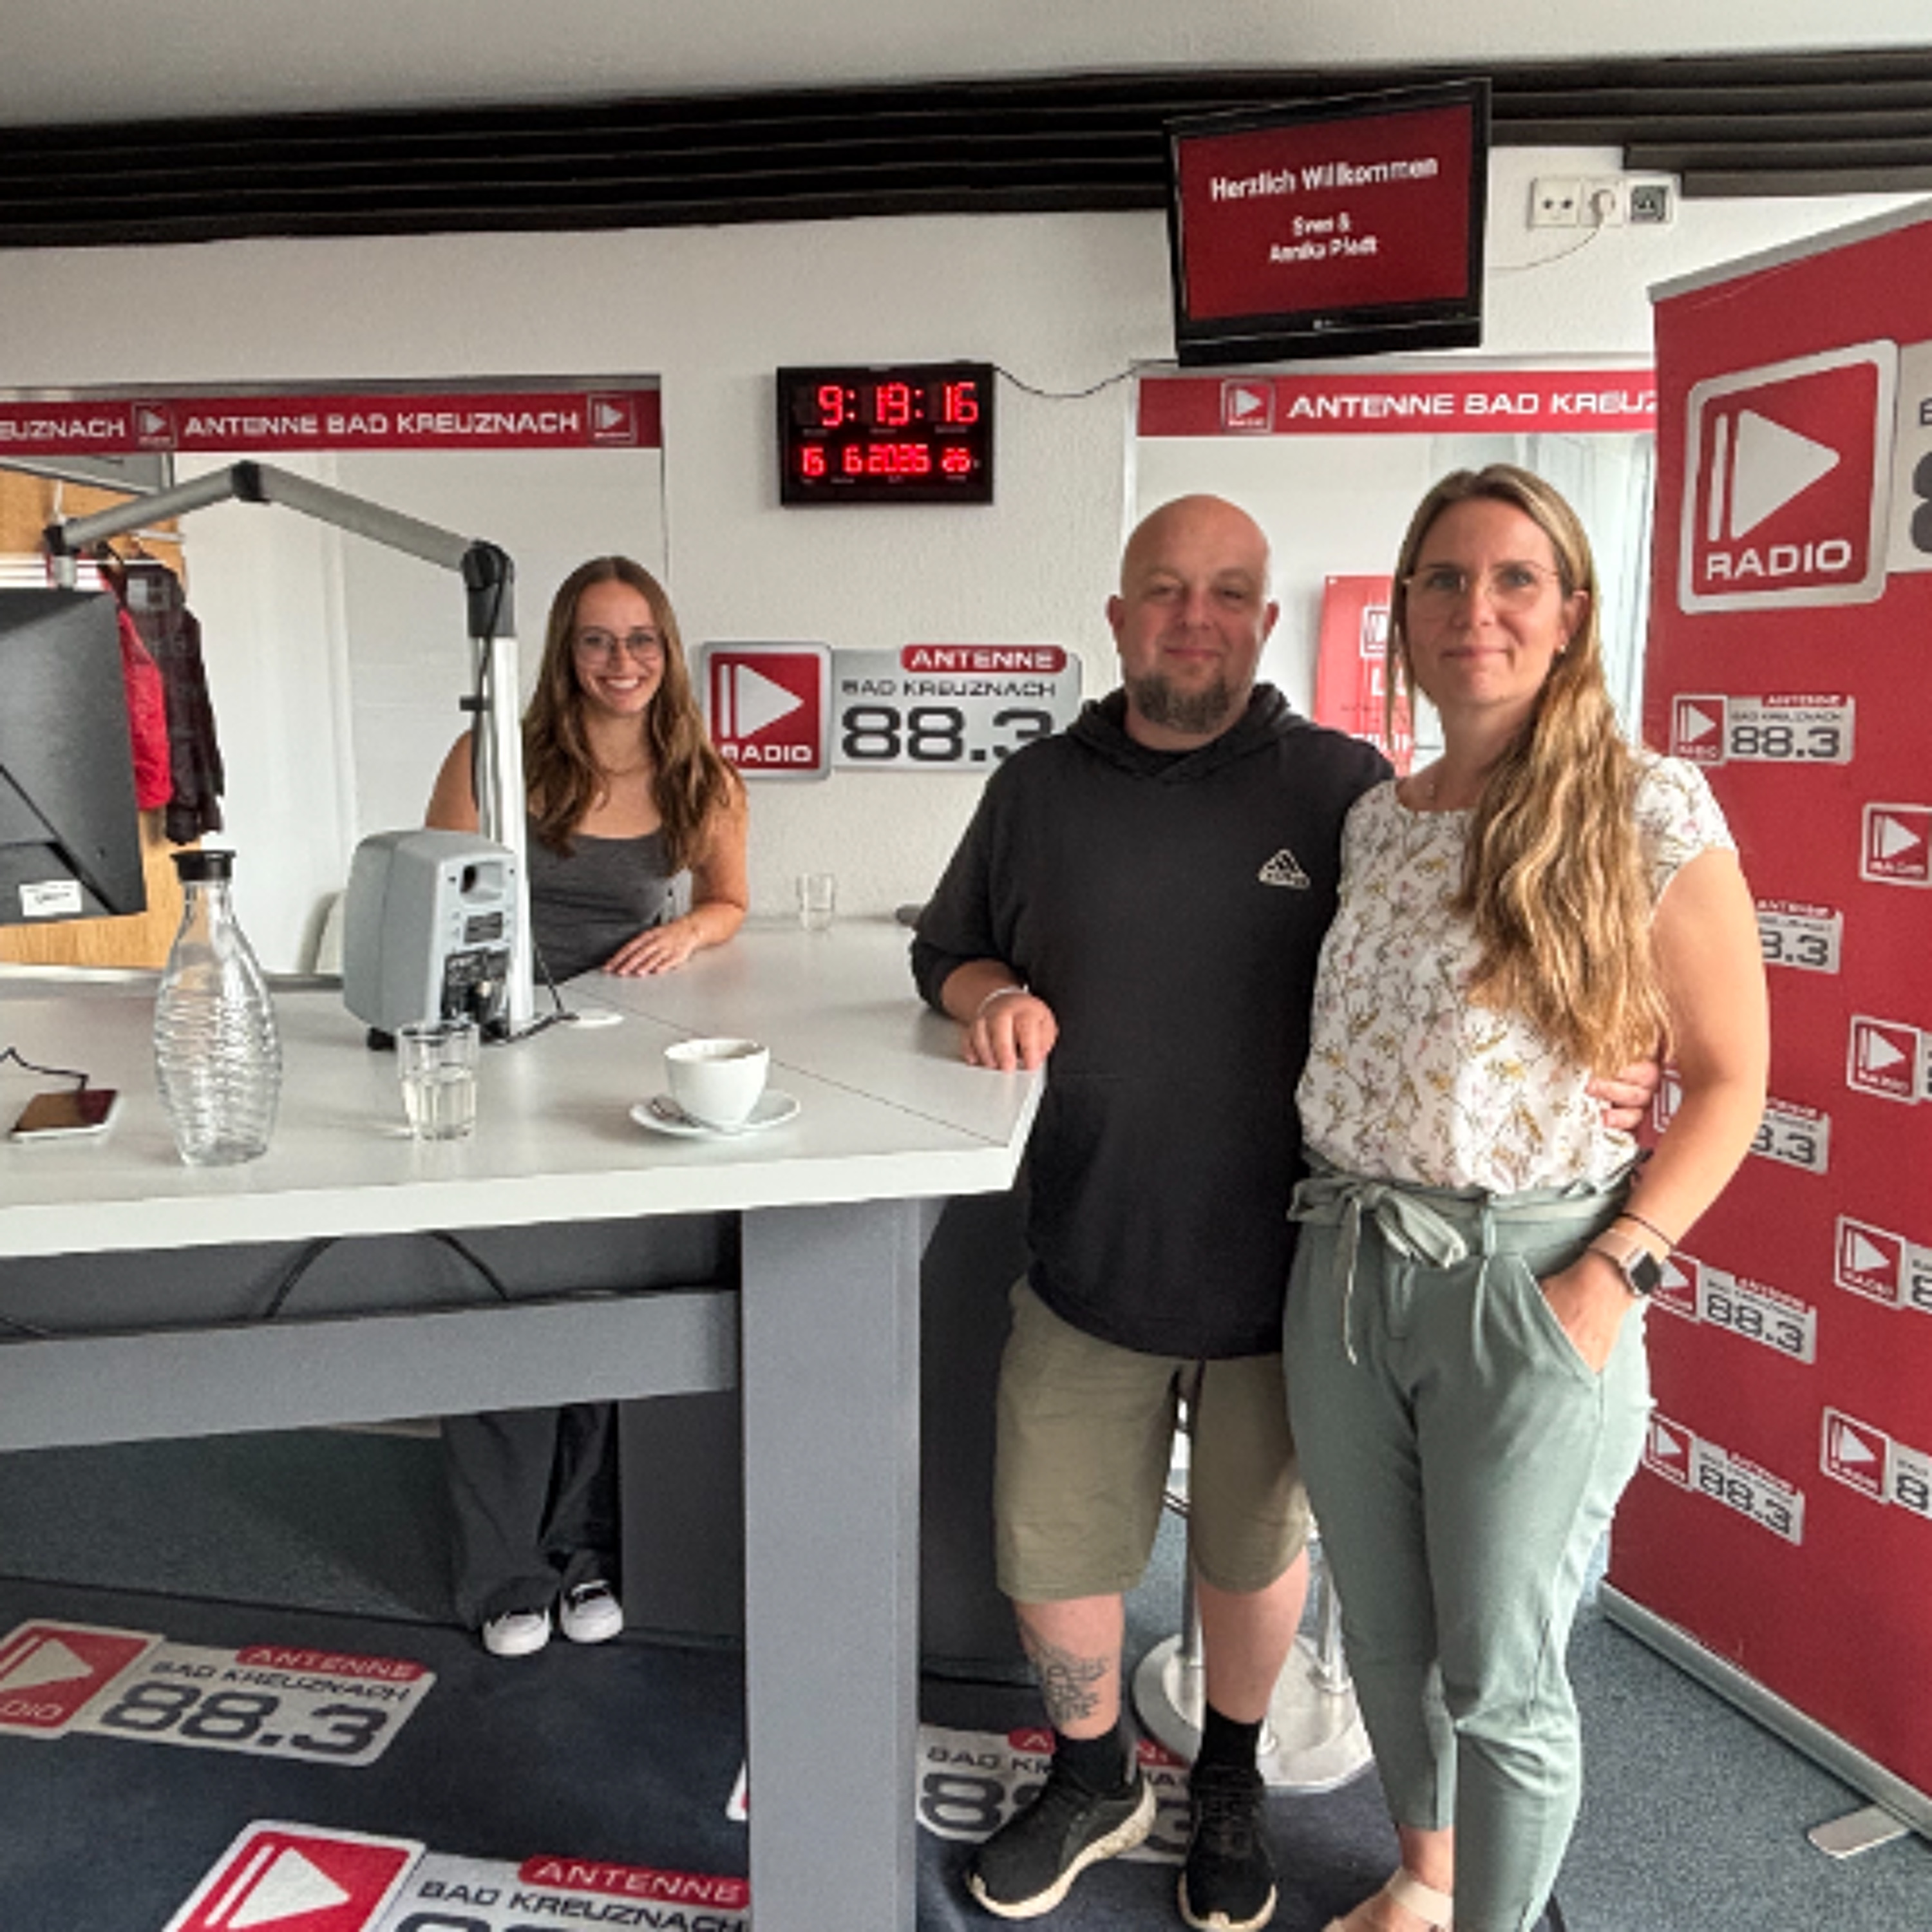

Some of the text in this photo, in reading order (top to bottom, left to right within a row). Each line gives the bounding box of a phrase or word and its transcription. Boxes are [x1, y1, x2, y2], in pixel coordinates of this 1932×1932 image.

[1211, 157, 1439, 201] Herzlich Willkommen
[1287, 393, 1454, 419] ANTENNE
[1463, 392, 1540, 415] BAD
[184, 412, 578, 437] ANTENNE BAD KREUZNACH
[1707, 540, 1852, 581] RADIO
[910, 650, 1055, 669] ANTENNE
[842, 679, 1056, 697] BAD KREUZNACH
[720, 744, 812, 762] RADIO
[1731, 725, 1841, 758] 88.3
[1707, 1293, 1803, 1354] 88.3
[1699, 1463, 1793, 1535] 88.3
[247, 1647, 420, 1679] ANTENNE
[150, 1660, 412, 1702] BAD KREUZNACH
[0, 1699, 64, 1720] DIO
[100, 1681, 388, 1755] 88.3
[927, 1746, 1000, 1770] BAD
[533, 1861, 741, 1903] ANTENNE
[418, 1880, 500, 1905] BAD
[509, 1892, 746, 1932] KREUZNACH
